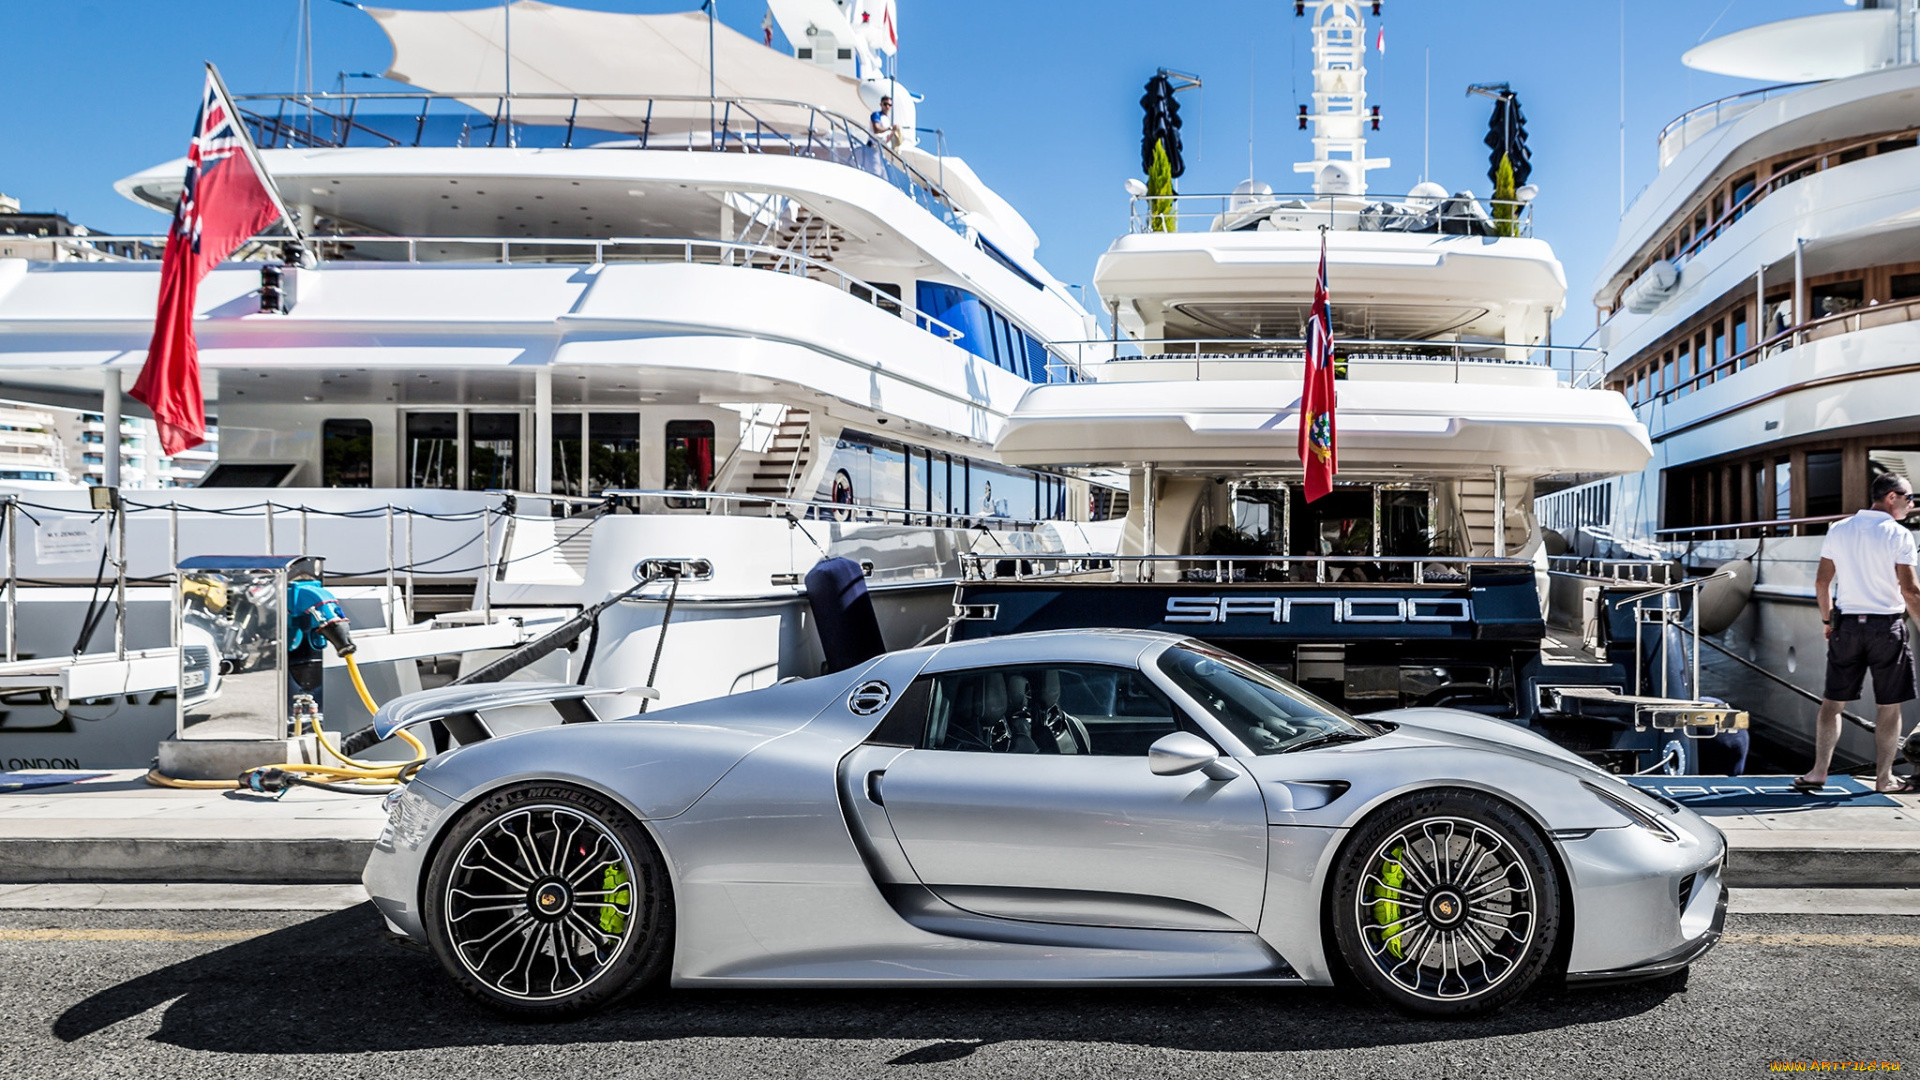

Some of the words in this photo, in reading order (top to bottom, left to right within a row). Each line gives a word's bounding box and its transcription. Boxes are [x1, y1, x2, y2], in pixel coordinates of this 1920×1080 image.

[527, 787, 605, 813] MICHELIN
[1358, 809, 1412, 853] MICHELIN
[1481, 962, 1535, 1009] MICHELIN
